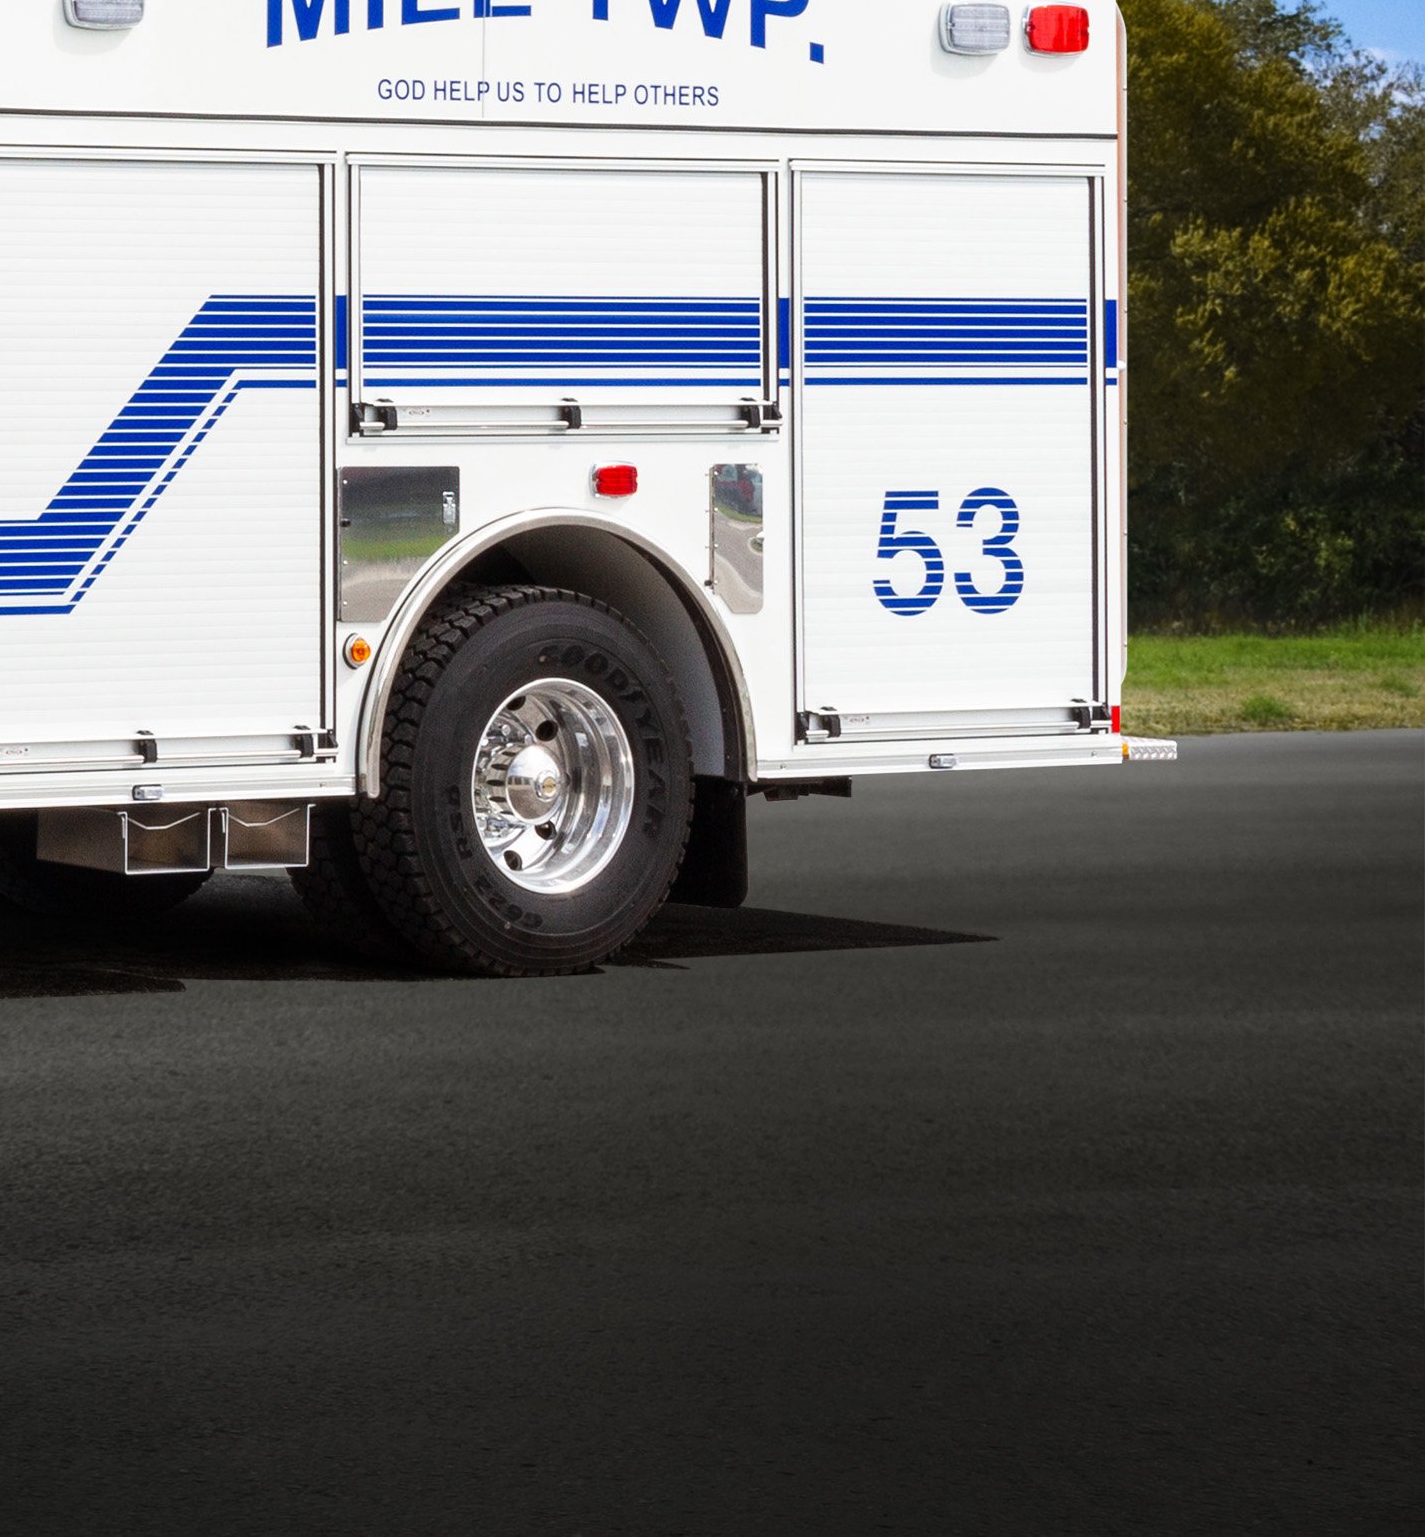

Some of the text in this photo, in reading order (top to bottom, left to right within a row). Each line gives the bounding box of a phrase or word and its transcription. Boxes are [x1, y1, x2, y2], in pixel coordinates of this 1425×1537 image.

[377, 78, 720, 107] GOD HELP US TO HELP OTHERS
[873, 487, 1024, 617] 53
[537, 644, 666, 839] GOODYEAR
